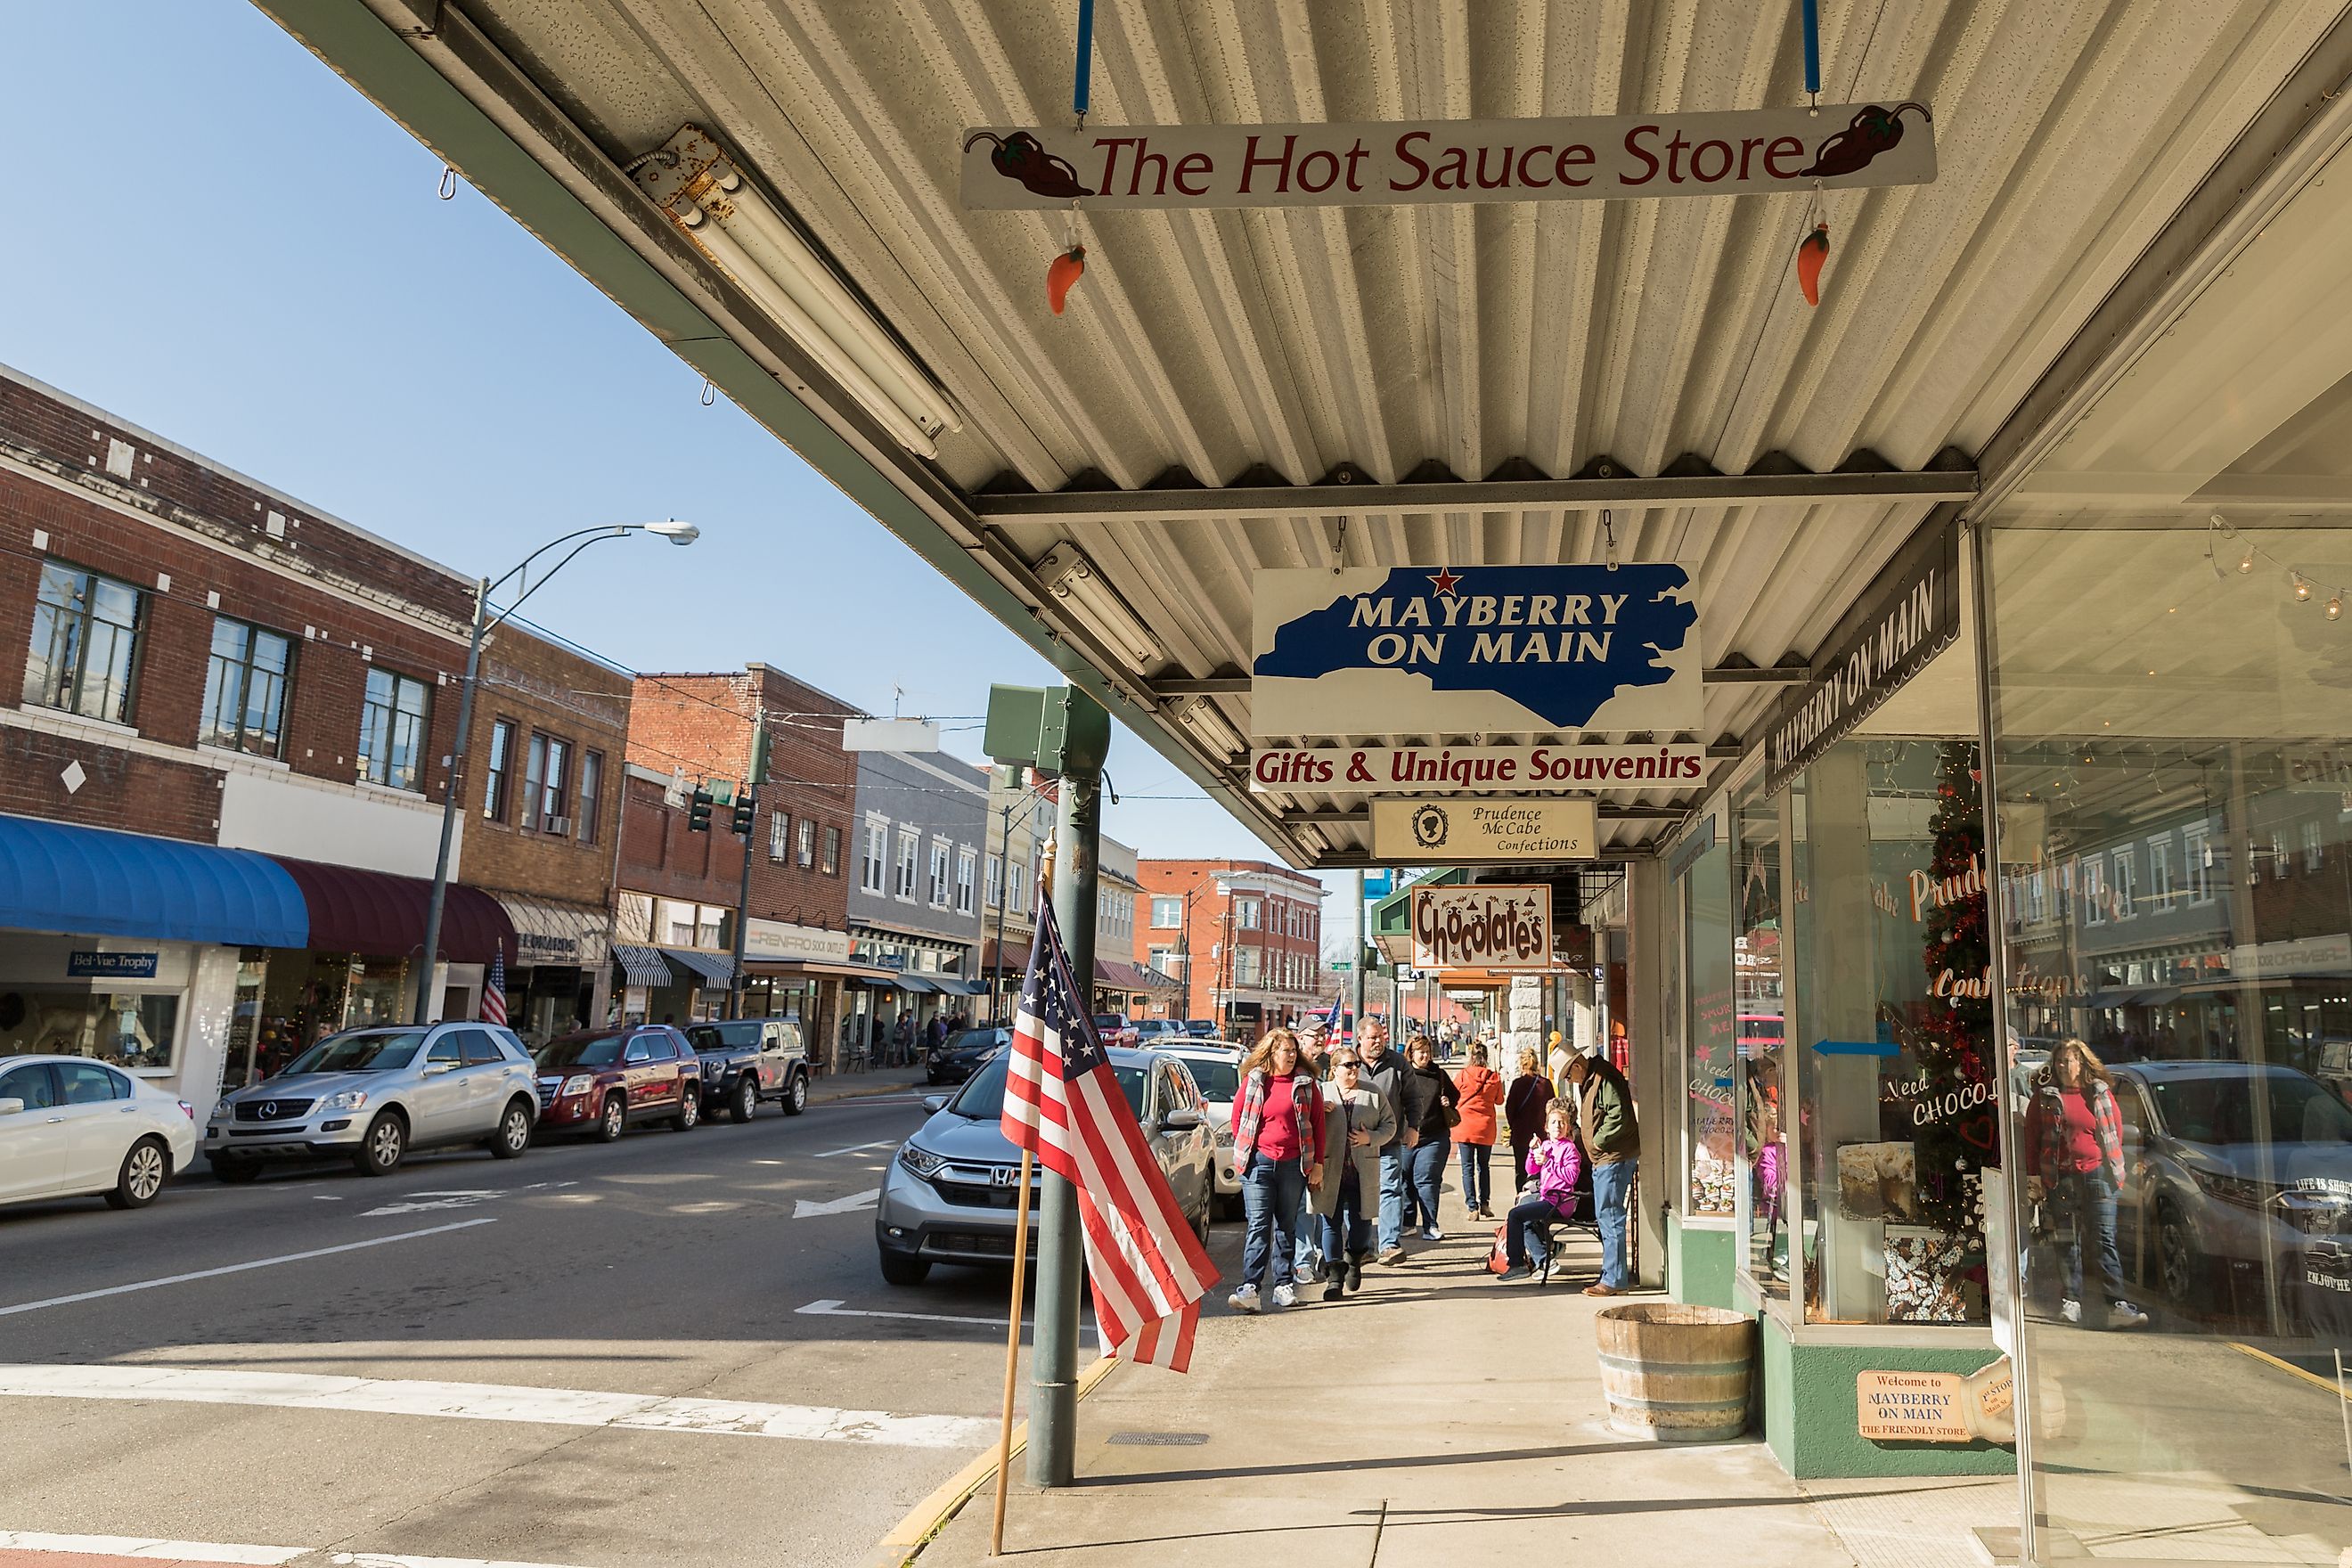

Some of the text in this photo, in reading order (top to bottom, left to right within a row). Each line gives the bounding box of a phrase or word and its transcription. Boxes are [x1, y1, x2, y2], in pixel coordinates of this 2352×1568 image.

[1090, 123, 1806, 196] The Hot Sauce Store
[1348, 594, 1629, 627] MAYBERRY
[1367, 631, 1613, 665] ON MAIN
[1774, 568, 1935, 774] MAYBERRY ON MAIN
[1254, 747, 1702, 787] Gifts & Unique Souvenirs
[1473, 804, 1542, 820] Prudence
[1497, 837, 1578, 853] Confections
[1417, 890, 1544, 965] Chocolates
[757, 932, 845, 954] RENFRO SOCK OUTLET
[118, 955, 155, 970] Trophy
[2296, 1178, 2315, 1192] LIFE
[2316, 1178, 2326, 1190] IS
[1877, 1376, 1941, 1387] Welcome to
[1868, 1392, 1951, 1406] MAYBERRY
[1878, 1408, 1943, 1420] ON MAIN
[1861, 1425, 1967, 1436] THE FRIENDLY STORE
